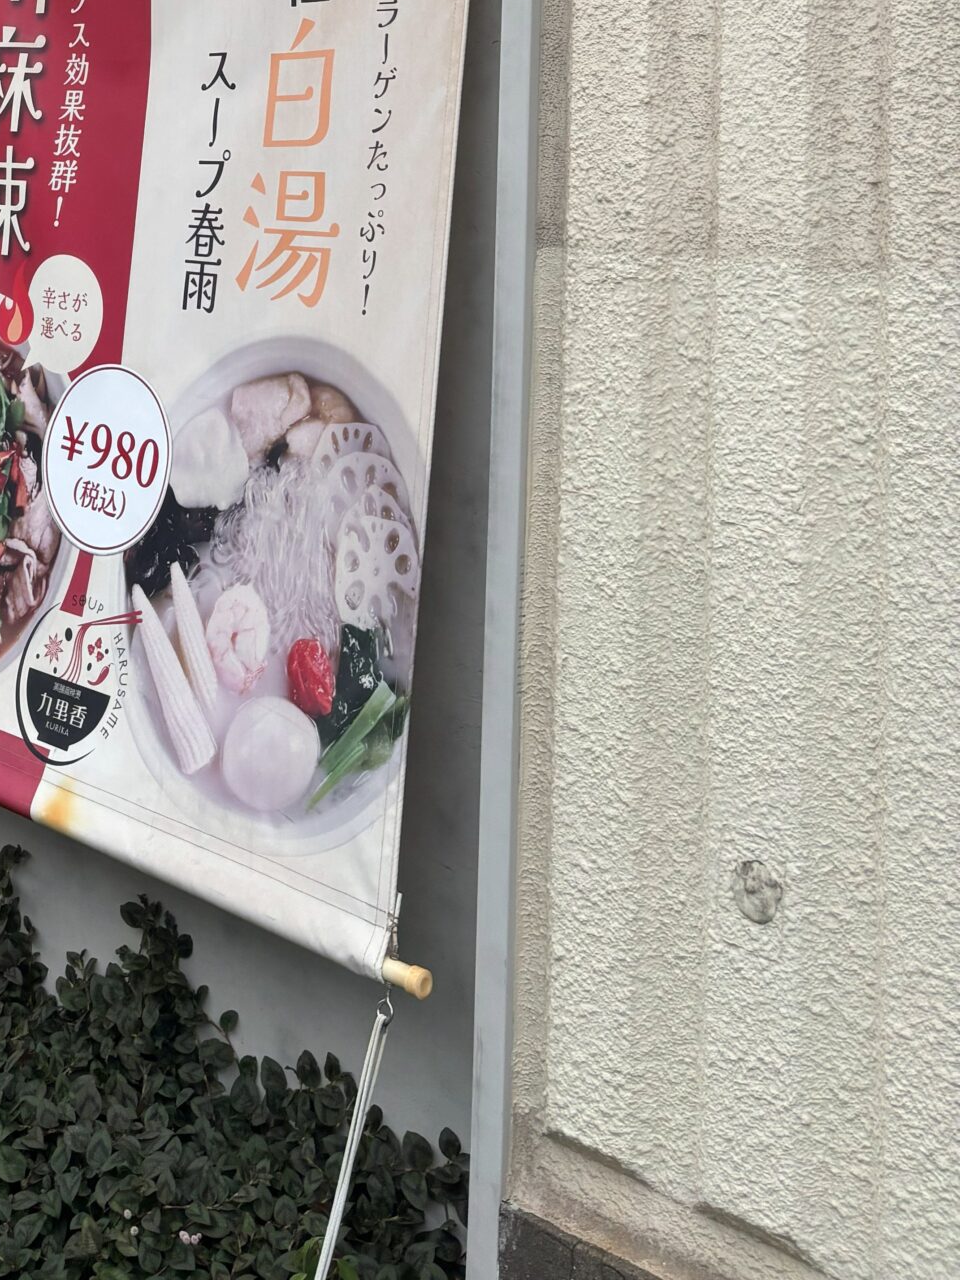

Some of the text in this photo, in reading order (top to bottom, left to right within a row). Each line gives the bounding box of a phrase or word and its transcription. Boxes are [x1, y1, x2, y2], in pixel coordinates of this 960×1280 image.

[182, 51, 237, 316] スープ春雨
[235, 17, 341, 310] 白湯
[42, 286, 89, 313] 辛さが
[40, 316, 83, 342] 選べる
[60, 415, 160, 488] ¥980
[73, 476, 127, 520] (税込)
[71, 593, 105, 616] SOUP
[100, 631, 129, 741] HARUSAME
[36, 691, 89, 730] 九里香
[45, 720, 70, 738] KURIKA
